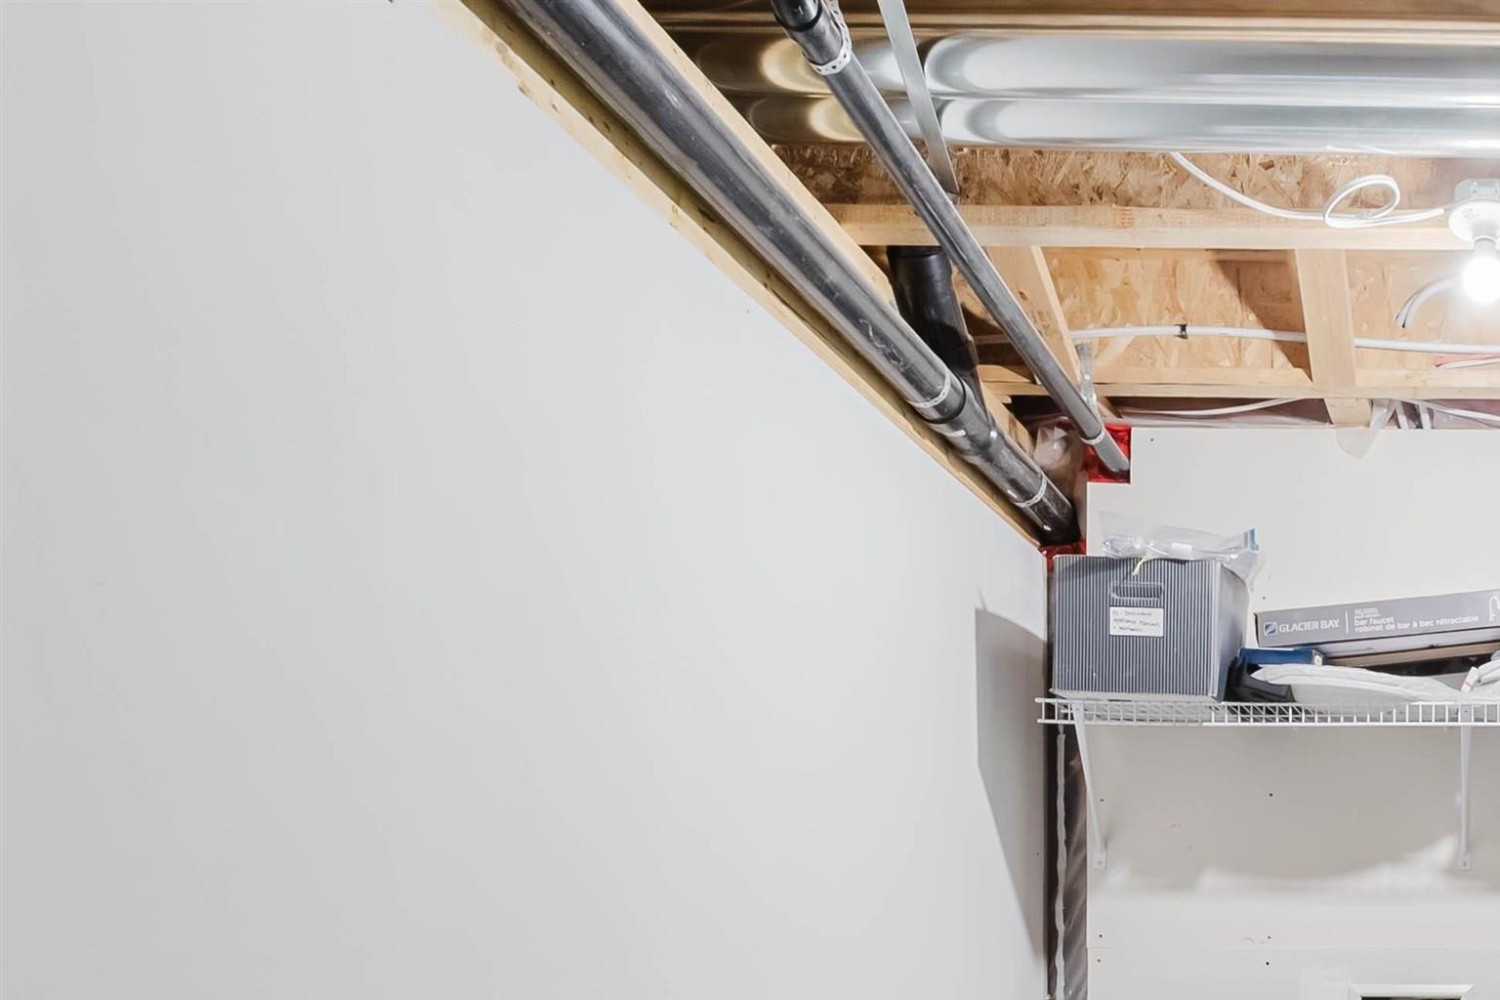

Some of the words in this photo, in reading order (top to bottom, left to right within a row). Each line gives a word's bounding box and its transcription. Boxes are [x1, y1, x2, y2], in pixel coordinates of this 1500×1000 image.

[1279, 622, 1319, 632] GLACIER
[1320, 619, 1340, 629] BAY
[1354, 617, 1368, 626] bar
[1369, 616, 1395, 625] faucet
[1355, 624, 1384, 632] robinet
[1397, 621, 1411, 629] bar
[1419, 619, 1435, 627] bec
